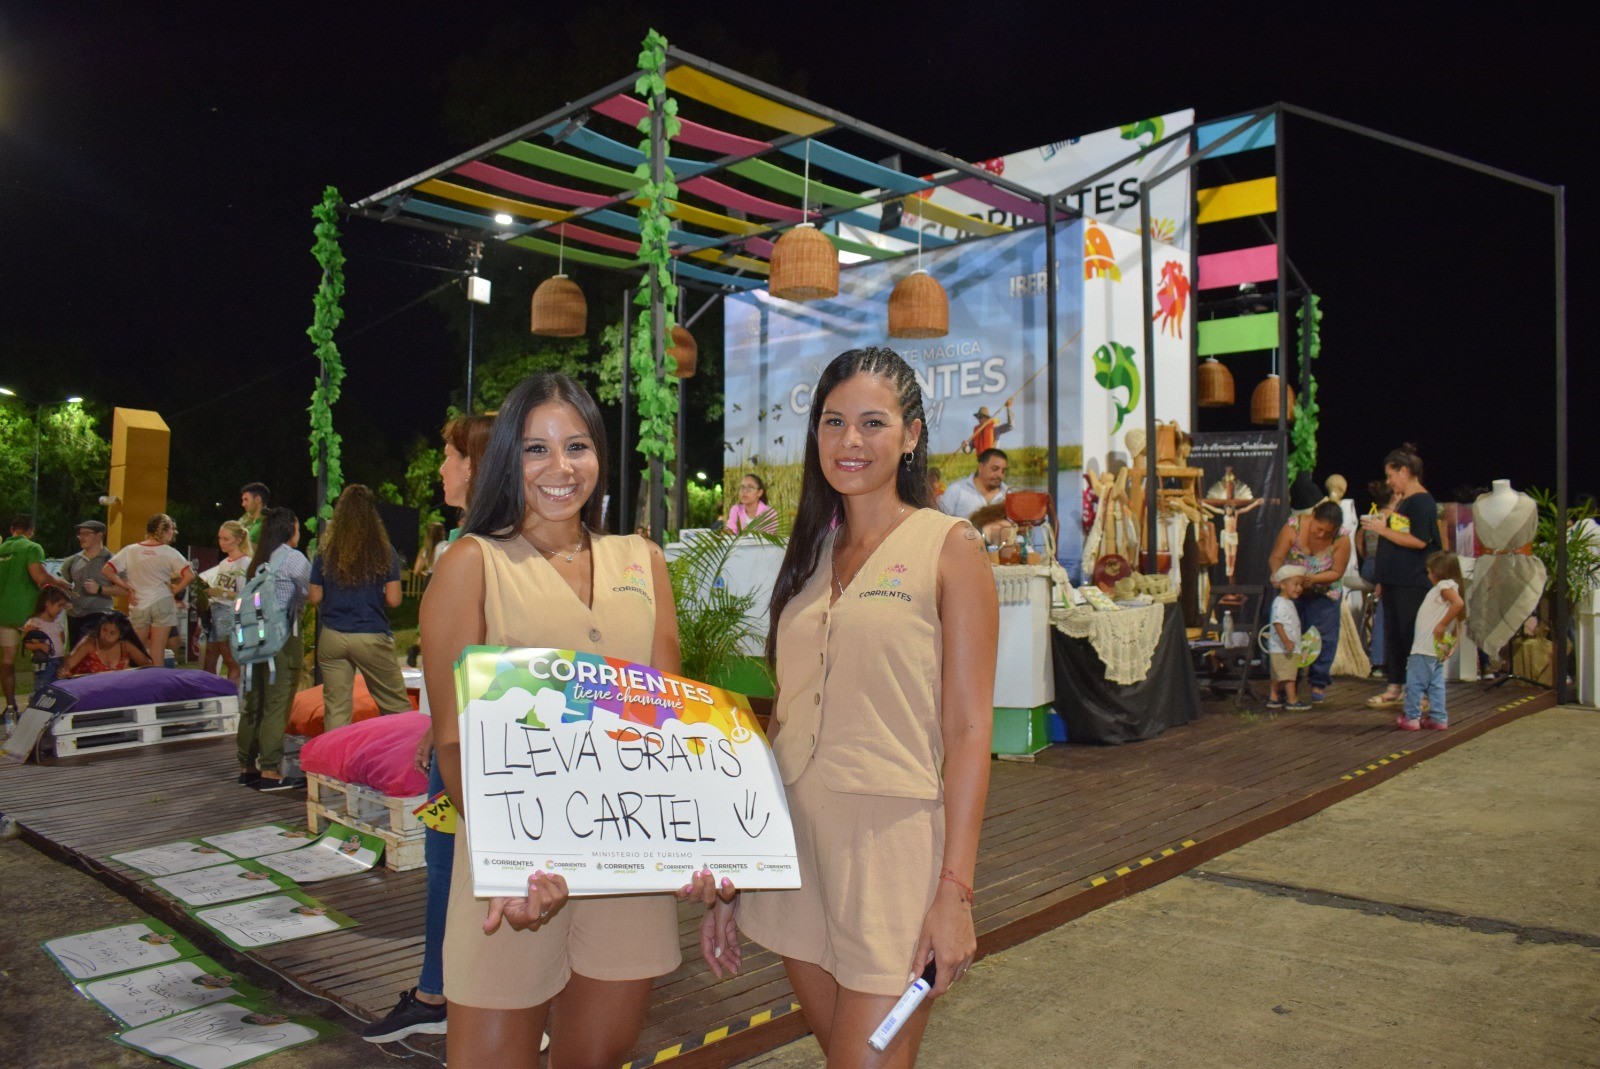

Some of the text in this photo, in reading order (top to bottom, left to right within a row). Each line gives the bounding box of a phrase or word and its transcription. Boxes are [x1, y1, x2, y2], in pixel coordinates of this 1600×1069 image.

[924, 341, 981, 360] MÁGICA
[858, 589, 912, 602] CORRIENTES
[528, 656, 715, 706] CORRIENTES
[573, 683, 685, 709] tiene chamamé
[484, 790, 716, 842] TU CARTEL
[491, 859, 534, 867] CORRIENTES
[591, 851, 640, 859] MINISTERIO
